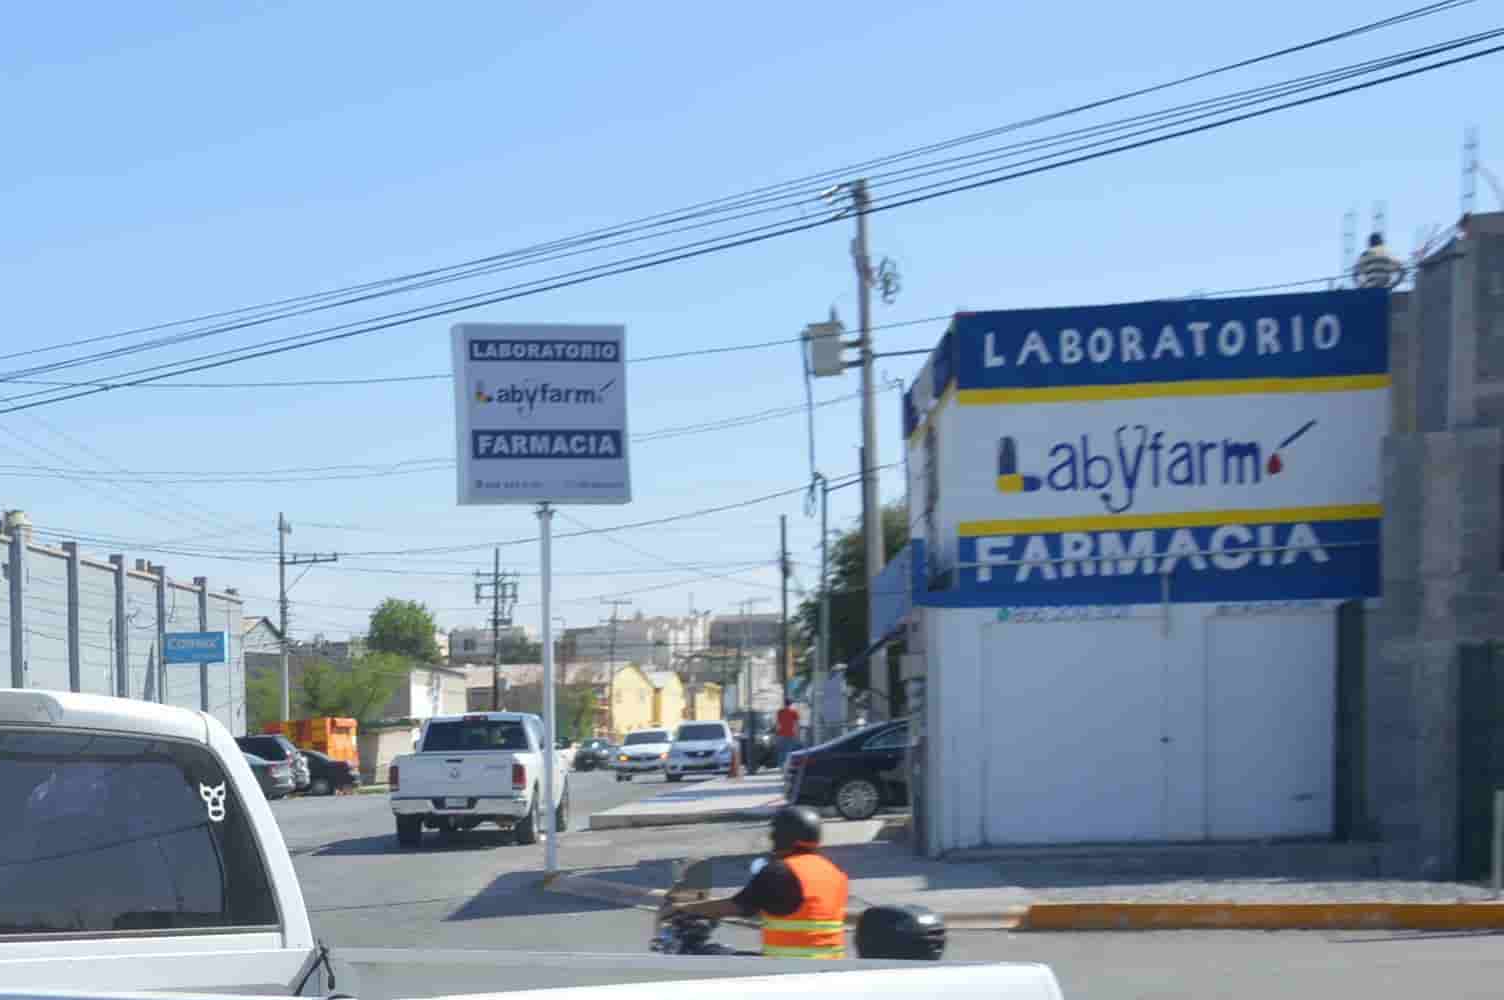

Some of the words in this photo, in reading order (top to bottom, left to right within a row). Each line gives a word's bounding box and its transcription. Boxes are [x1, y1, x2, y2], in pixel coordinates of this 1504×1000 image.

[473, 343, 617, 359] LABORATORIO
[983, 314, 1341, 368] LABORATORIO
[474, 377, 596, 417] Labyfarm
[477, 434, 617, 456] FARMACIA
[996, 424, 1262, 514] Labyfarm
[974, 522, 1331, 583] FARMACIA
